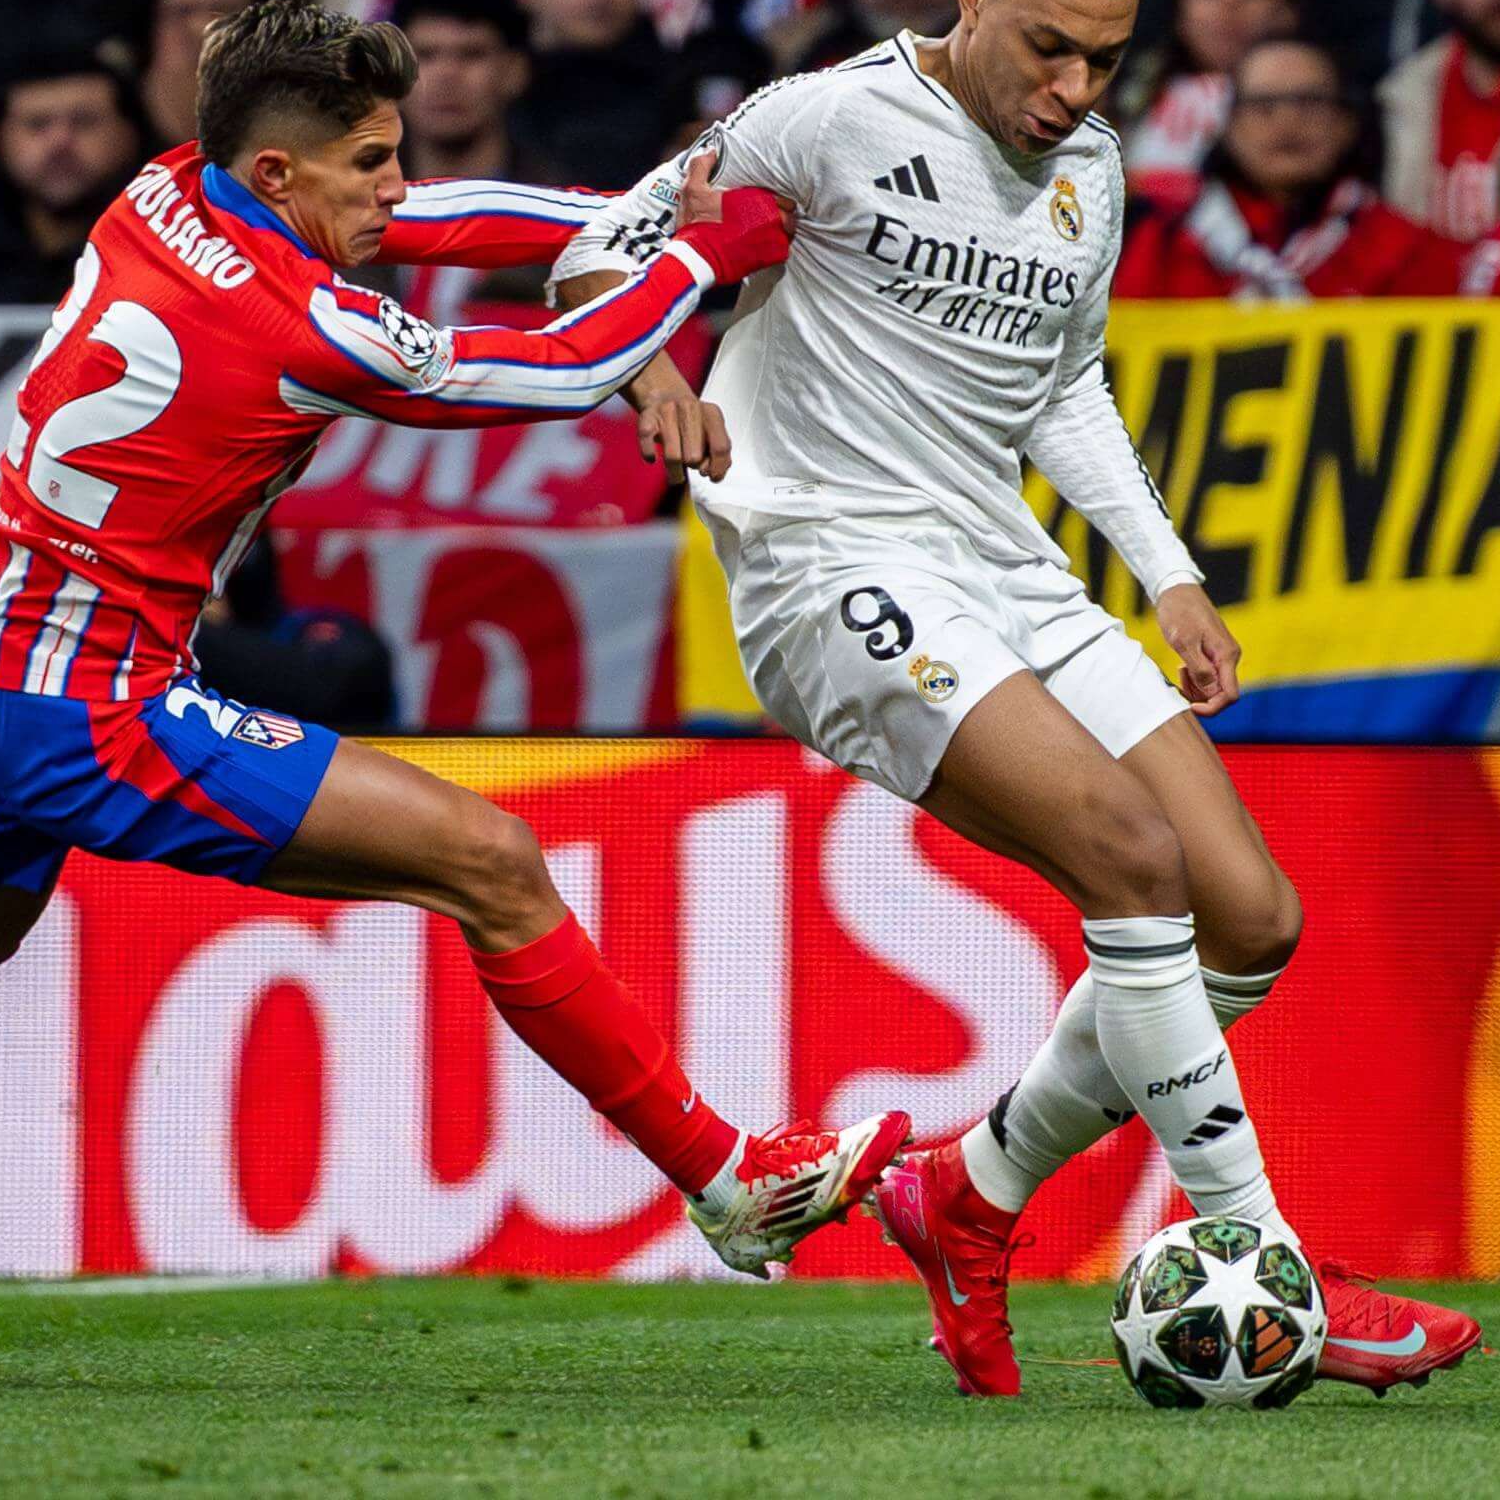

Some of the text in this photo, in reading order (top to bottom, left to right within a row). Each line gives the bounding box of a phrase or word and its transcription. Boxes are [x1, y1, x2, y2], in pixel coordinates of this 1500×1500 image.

[866, 213, 1079, 308] Emirates
[875, 278, 1042, 348] FLY BETTER
[840, 585, 914, 661] 9
[164, 679, 248, 740] 2
